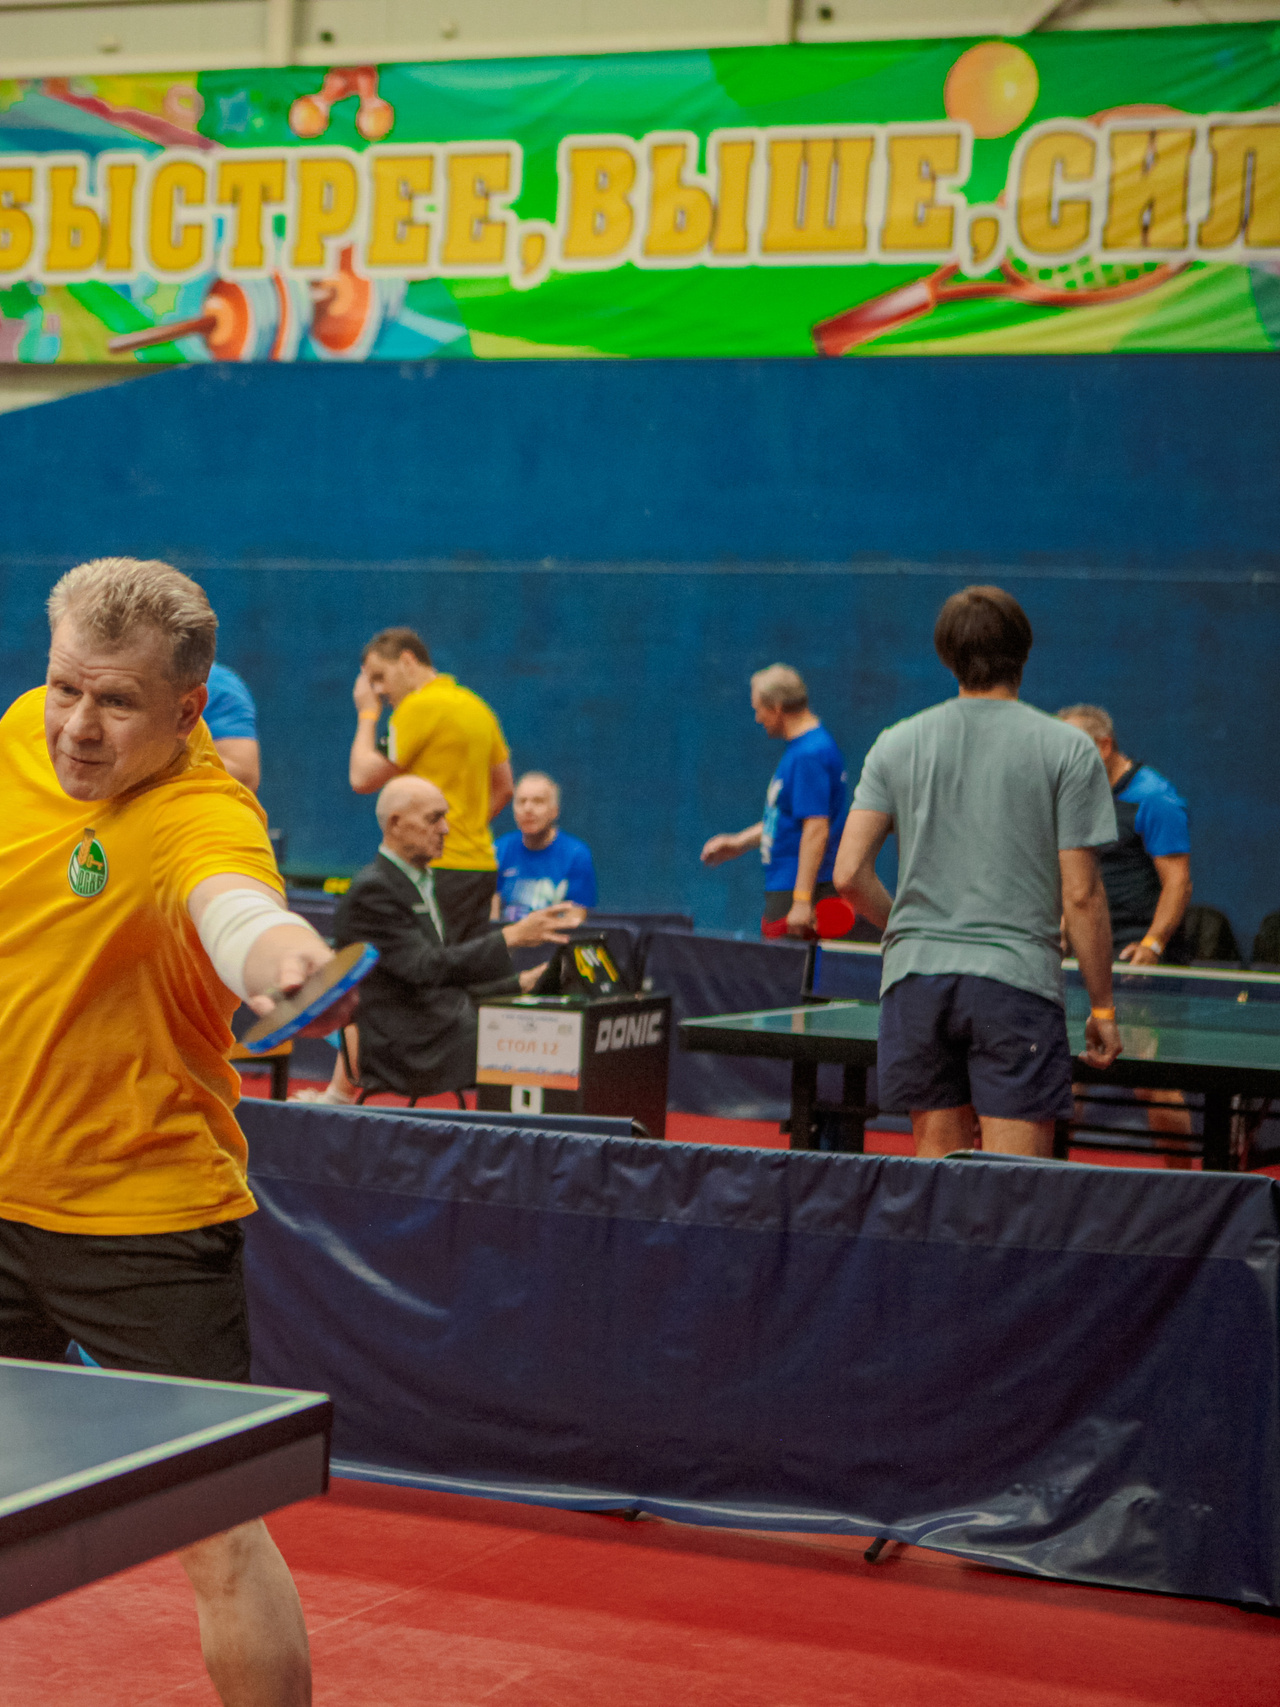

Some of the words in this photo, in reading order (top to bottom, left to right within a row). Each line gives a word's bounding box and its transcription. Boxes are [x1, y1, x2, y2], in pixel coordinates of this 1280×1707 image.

[562, 128, 1004, 270] ВЫШЕ,
[497, 1038, 537, 1054] СТОЛ
[542, 1041, 560, 1056] 12
[595, 1009, 663, 1053] DONIC
